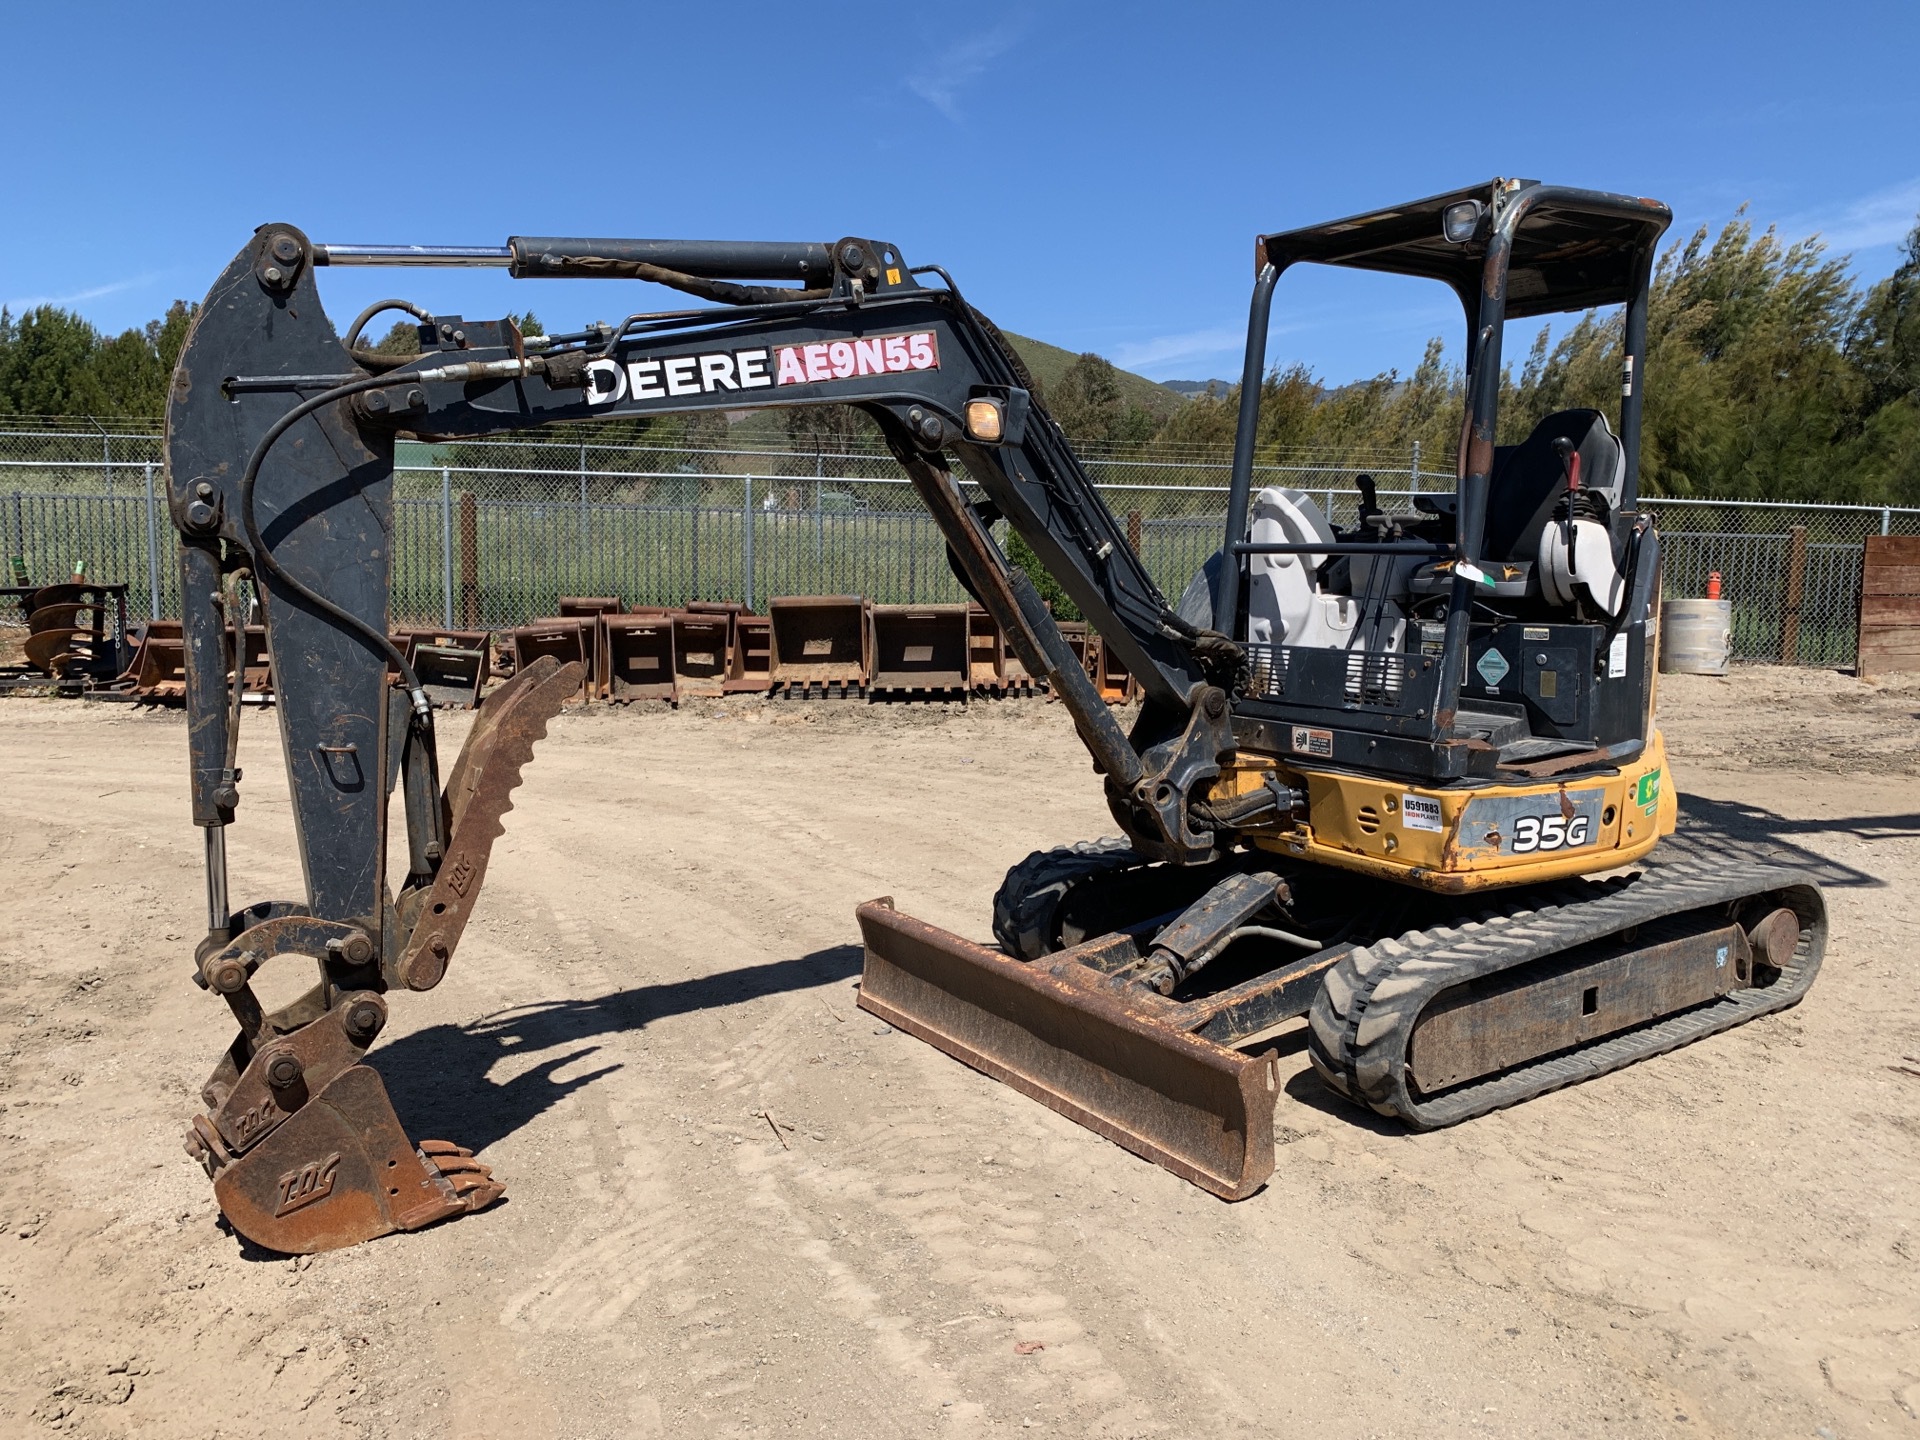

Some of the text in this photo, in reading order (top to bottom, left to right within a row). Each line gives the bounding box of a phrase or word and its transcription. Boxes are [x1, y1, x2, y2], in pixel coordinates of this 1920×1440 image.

[586, 333, 934, 405] DEERE AE9N55
[1405, 799, 1439, 814] U591883
[1511, 814, 1589, 853] 35G
[275, 1152, 341, 1219] TAG
